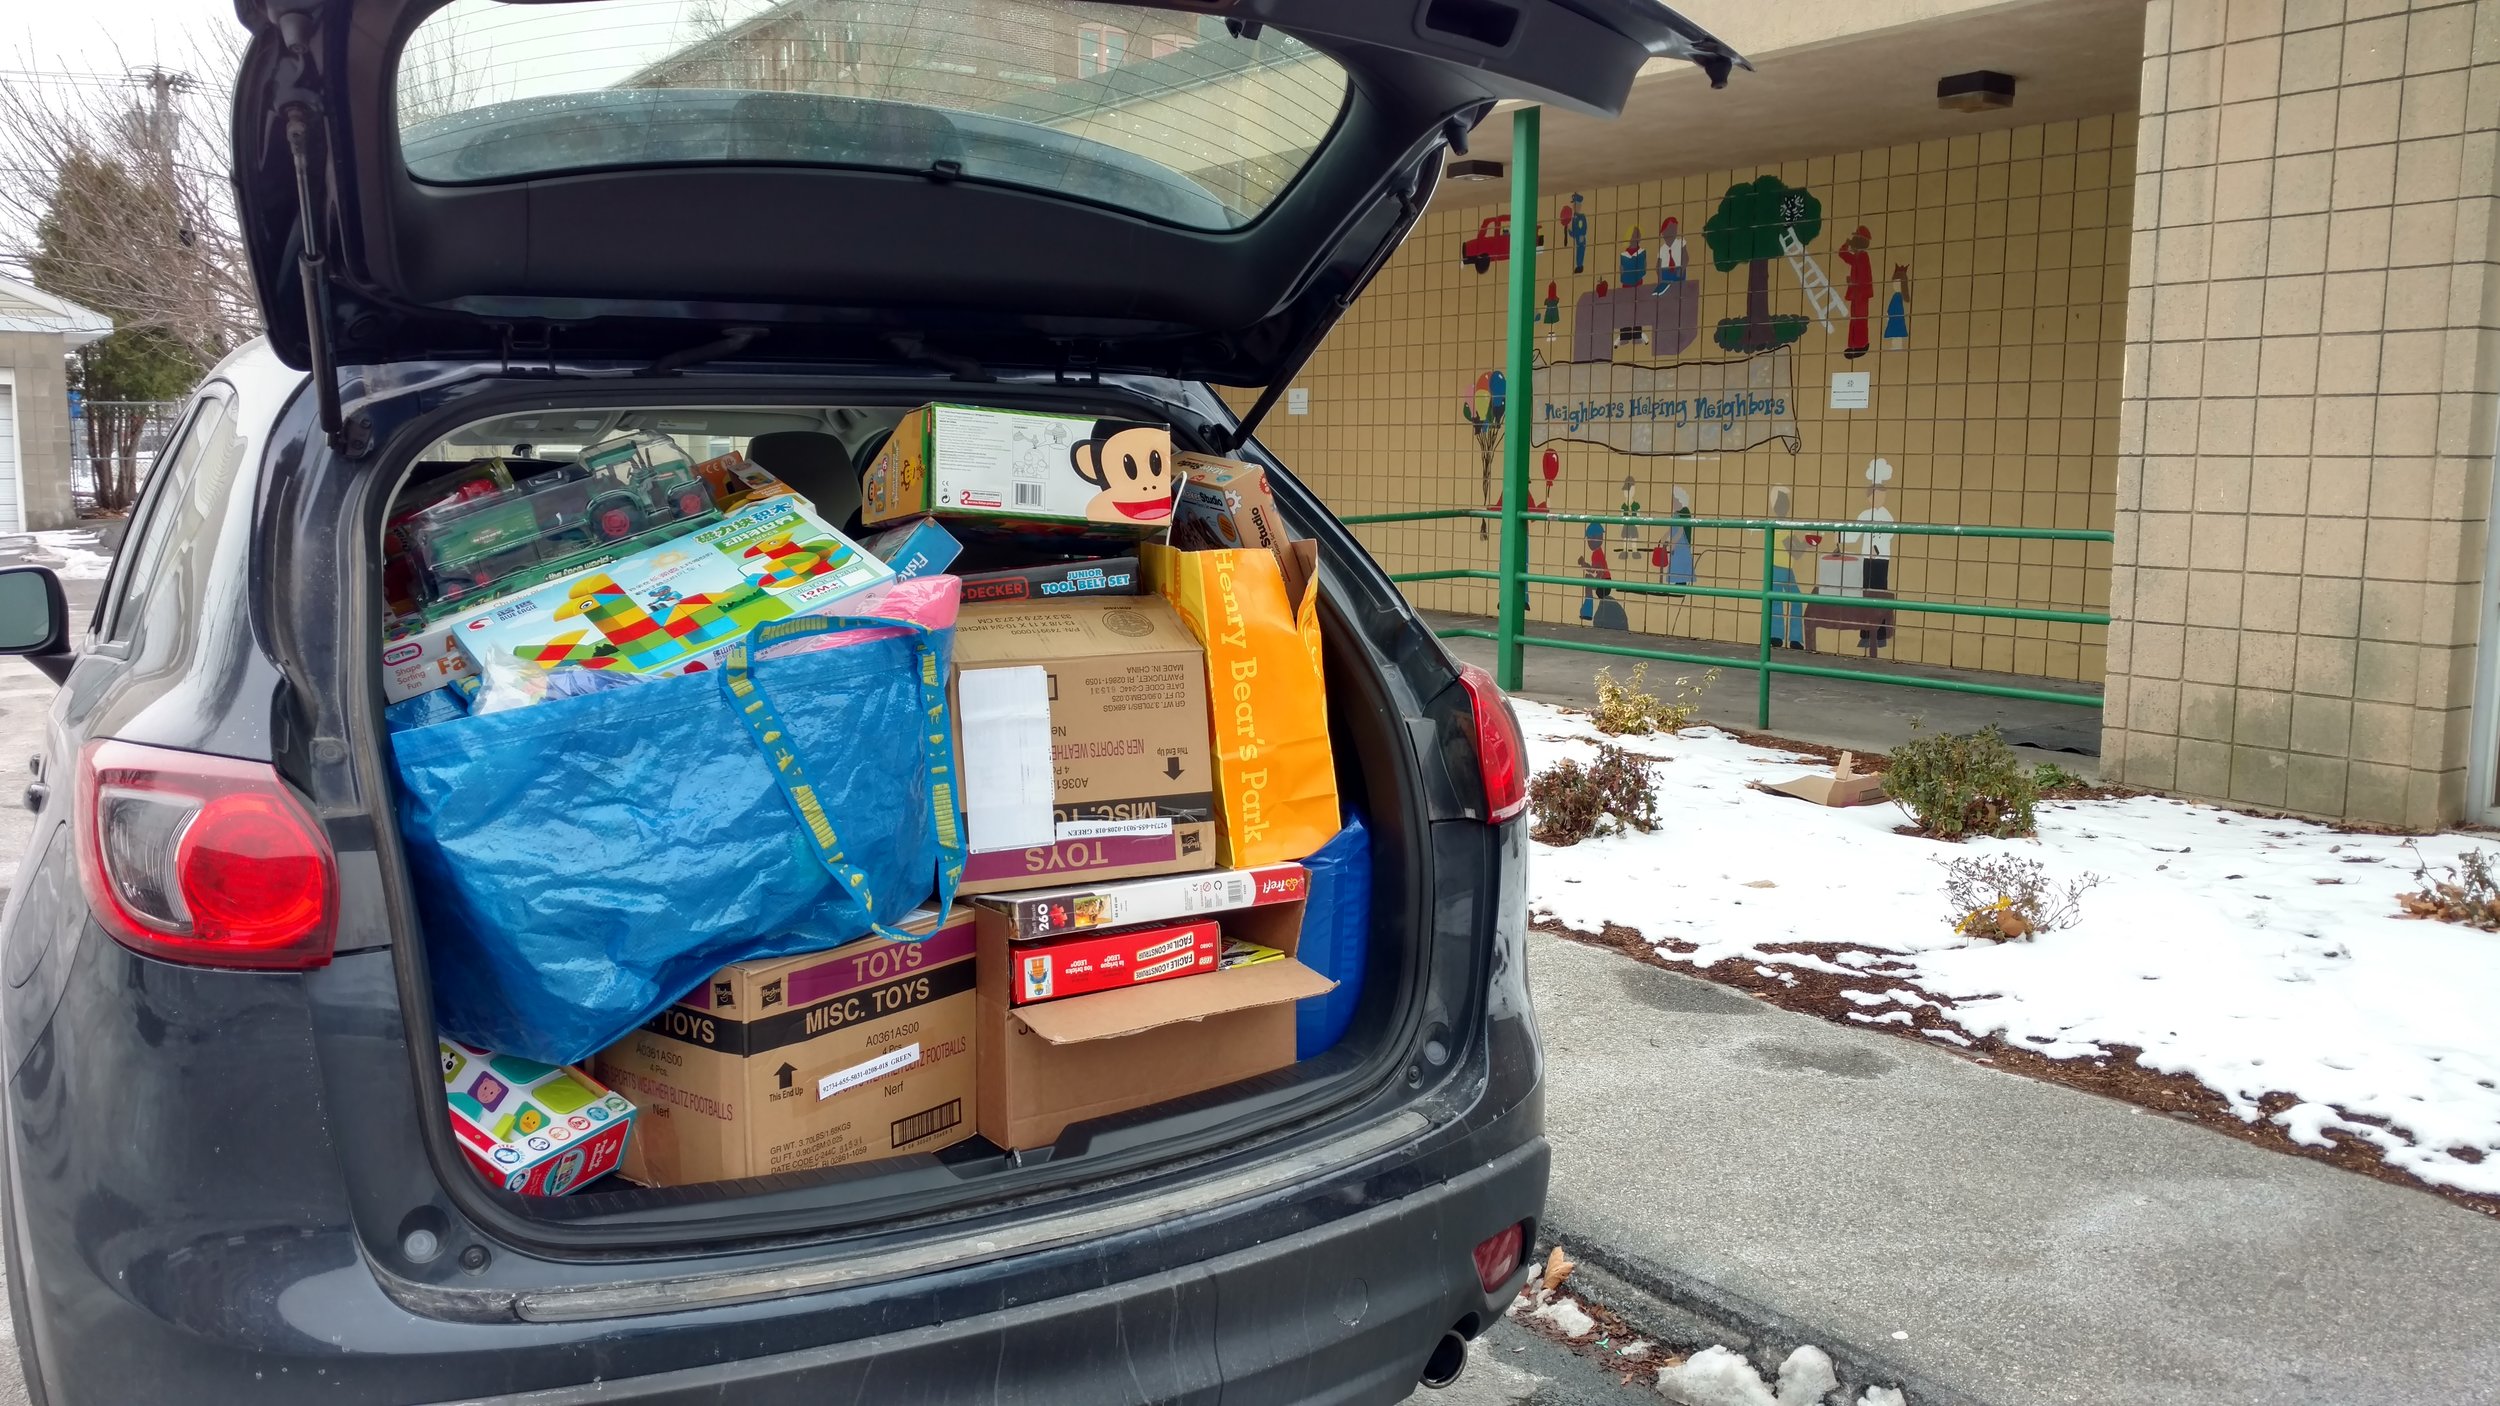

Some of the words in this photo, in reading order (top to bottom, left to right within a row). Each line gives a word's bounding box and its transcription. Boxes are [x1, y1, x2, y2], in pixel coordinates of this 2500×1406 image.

[1544, 401, 1624, 432] Neighbors
[1628, 397, 1687, 428] Helping
[1694, 392, 1785, 431] Neighbors
[1252, 507, 1270, 548] Studio
[898, 552, 928, 582] Fishe
[1067, 569, 1103, 580] JUNIOR
[1041, 582, 1077, 595] TOOL
[1078, 578, 1106, 591] BELT
[1109, 574, 1130, 586] SET
[1214, 549, 1247, 650] Henry
[500, 612, 517, 622] BLUE
[518, 604, 538, 615] EAGLE
[395, 664, 421, 677] Shape
[437, 656, 467, 675] Fa
[1162, 664, 1184, 672] MADE
[397, 671, 426, 685] Sorting
[407, 681, 422, 690] Fun
[1085, 677, 1125, 685] 02861-1059
[1120, 685, 1144, 693] C-244C
[1163, 692, 1173, 700] FT.
[1229, 656, 1264, 763] Bear's
[1052, 726, 1066, 736] Ne
[1052, 743, 1087, 760] WEATHE
[1090, 740, 1123, 758] SPORTS
[1127, 739, 1144, 755] NER
[1157, 748, 1165, 756] Up
[1176, 747, 1188, 755] This
[1055, 778, 1088, 788] A0361
[1241, 768, 1270, 844] Park
[1068, 828, 1092, 836] GREEN
[1024, 841, 1108, 871] TOYS
[1262, 878, 1286, 894] Trefl
[1038, 904, 1050, 932] 260
[1173, 935, 1192, 948] FACIL
[1138, 945, 1166, 959] CONSTRUIR
[852, 943, 923, 982] TOYS
[1100, 959, 1119, 969] brique
[1171, 954, 1193, 968] FACILE
[1199, 956, 1213, 965] LEGO
[1135, 964, 1166, 979] CONSTRUIRE
[806, 998, 865, 1034] MISC.
[872, 978, 930, 1012] TOYS
[664, 1010, 715, 1043] TOYS
[866, 1021, 920, 1047] A0361AS00
[636, 1041, 682, 1067] A0361AS00
[889, 1044, 903, 1054] Pcs
[927, 1036, 966, 1065] FOOTBALLS
[655, 1065, 669, 1077] Pcs.
[822, 1061, 889, 1093] 92734-655-5031-0208-018
[891, 1052, 912, 1065] GREEN
[610, 1067, 637, 1088] SPORTS
[637, 1077, 669, 1100] WEATHER
[670, 1086, 689, 1108] BLITZ
[690, 1093, 733, 1121] FOOTBALLS
[769, 1092, 782, 1103] This
[783, 1090, 795, 1099] End
[795, 1087, 804, 1097] Up
[884, 1081, 904, 1097] Nerf
[653, 1103, 670, 1118] Nerf
[770, 1146, 782, 1155] GR
[783, 1142, 797, 1152] WT.
[831, 1146, 867, 1166] 02861-1059
[771, 1156, 782, 1165] CU
[783, 1152, 795, 1162] FT.
[792, 1156, 813, 1169] CODE
